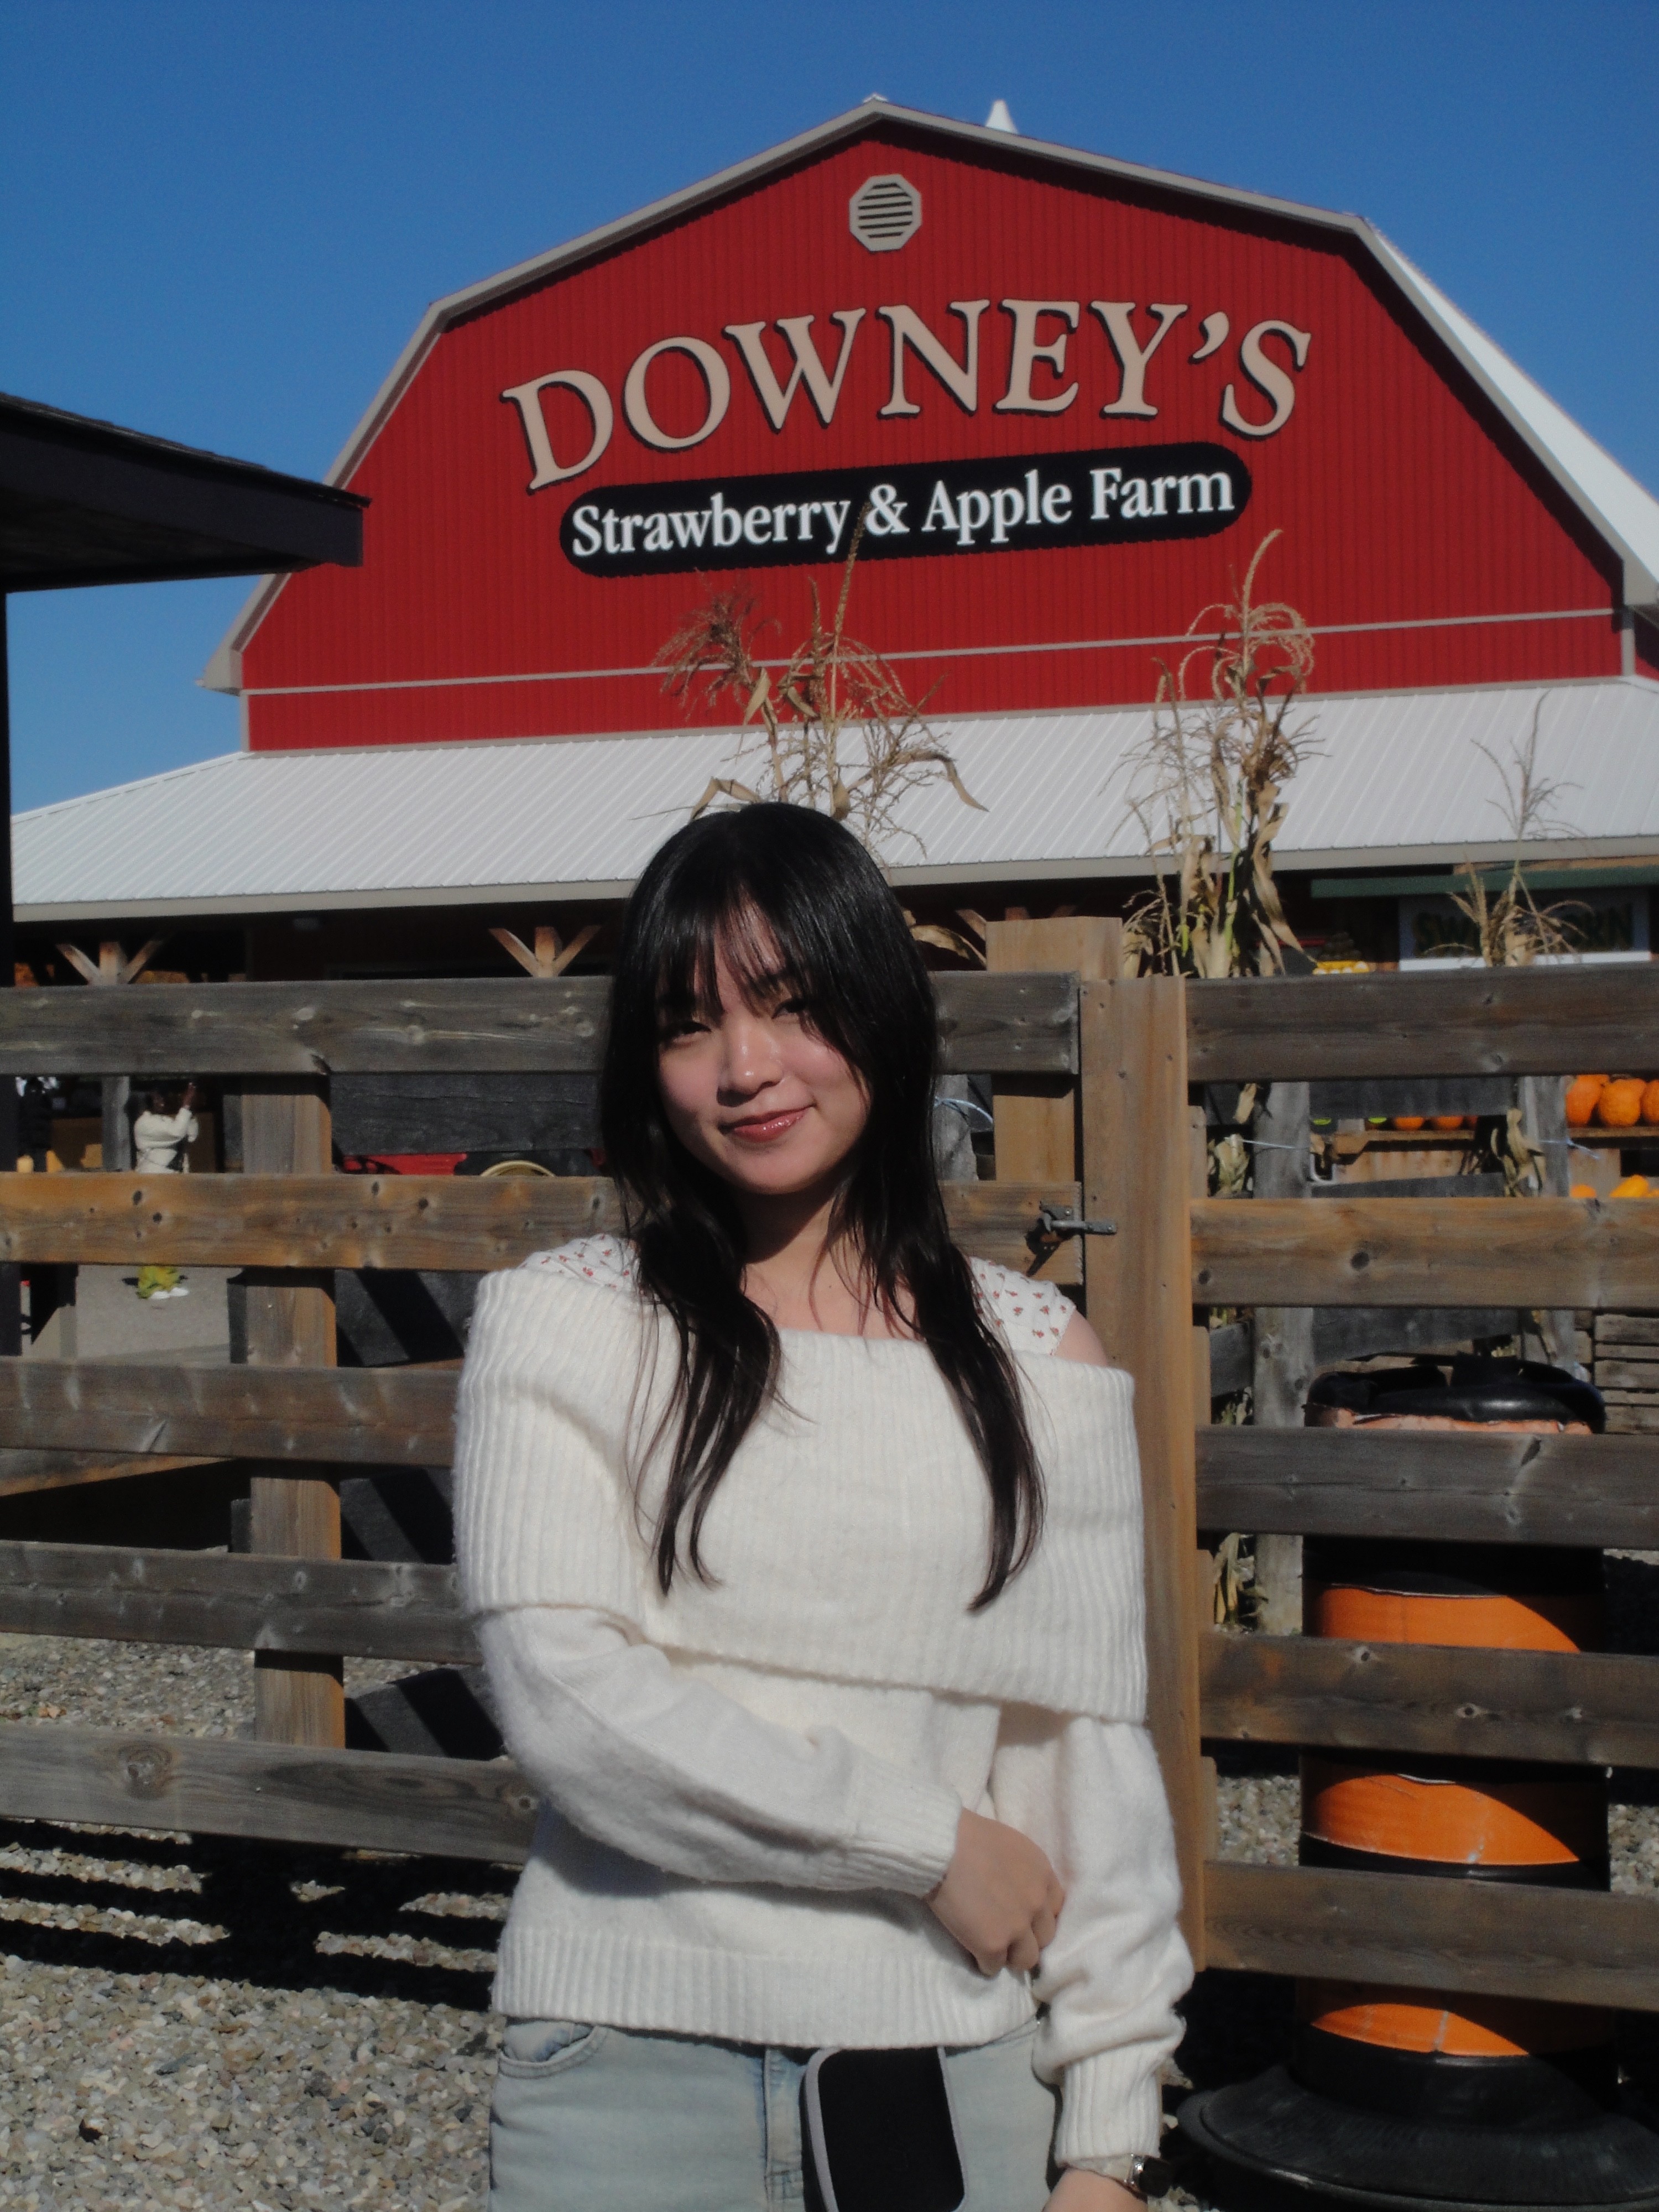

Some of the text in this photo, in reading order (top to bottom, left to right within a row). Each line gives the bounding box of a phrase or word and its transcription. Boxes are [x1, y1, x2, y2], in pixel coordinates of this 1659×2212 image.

[502, 298, 1312, 490] DOWNEY'S
[572, 467, 1235, 557] Strawberry & Apple Farm
